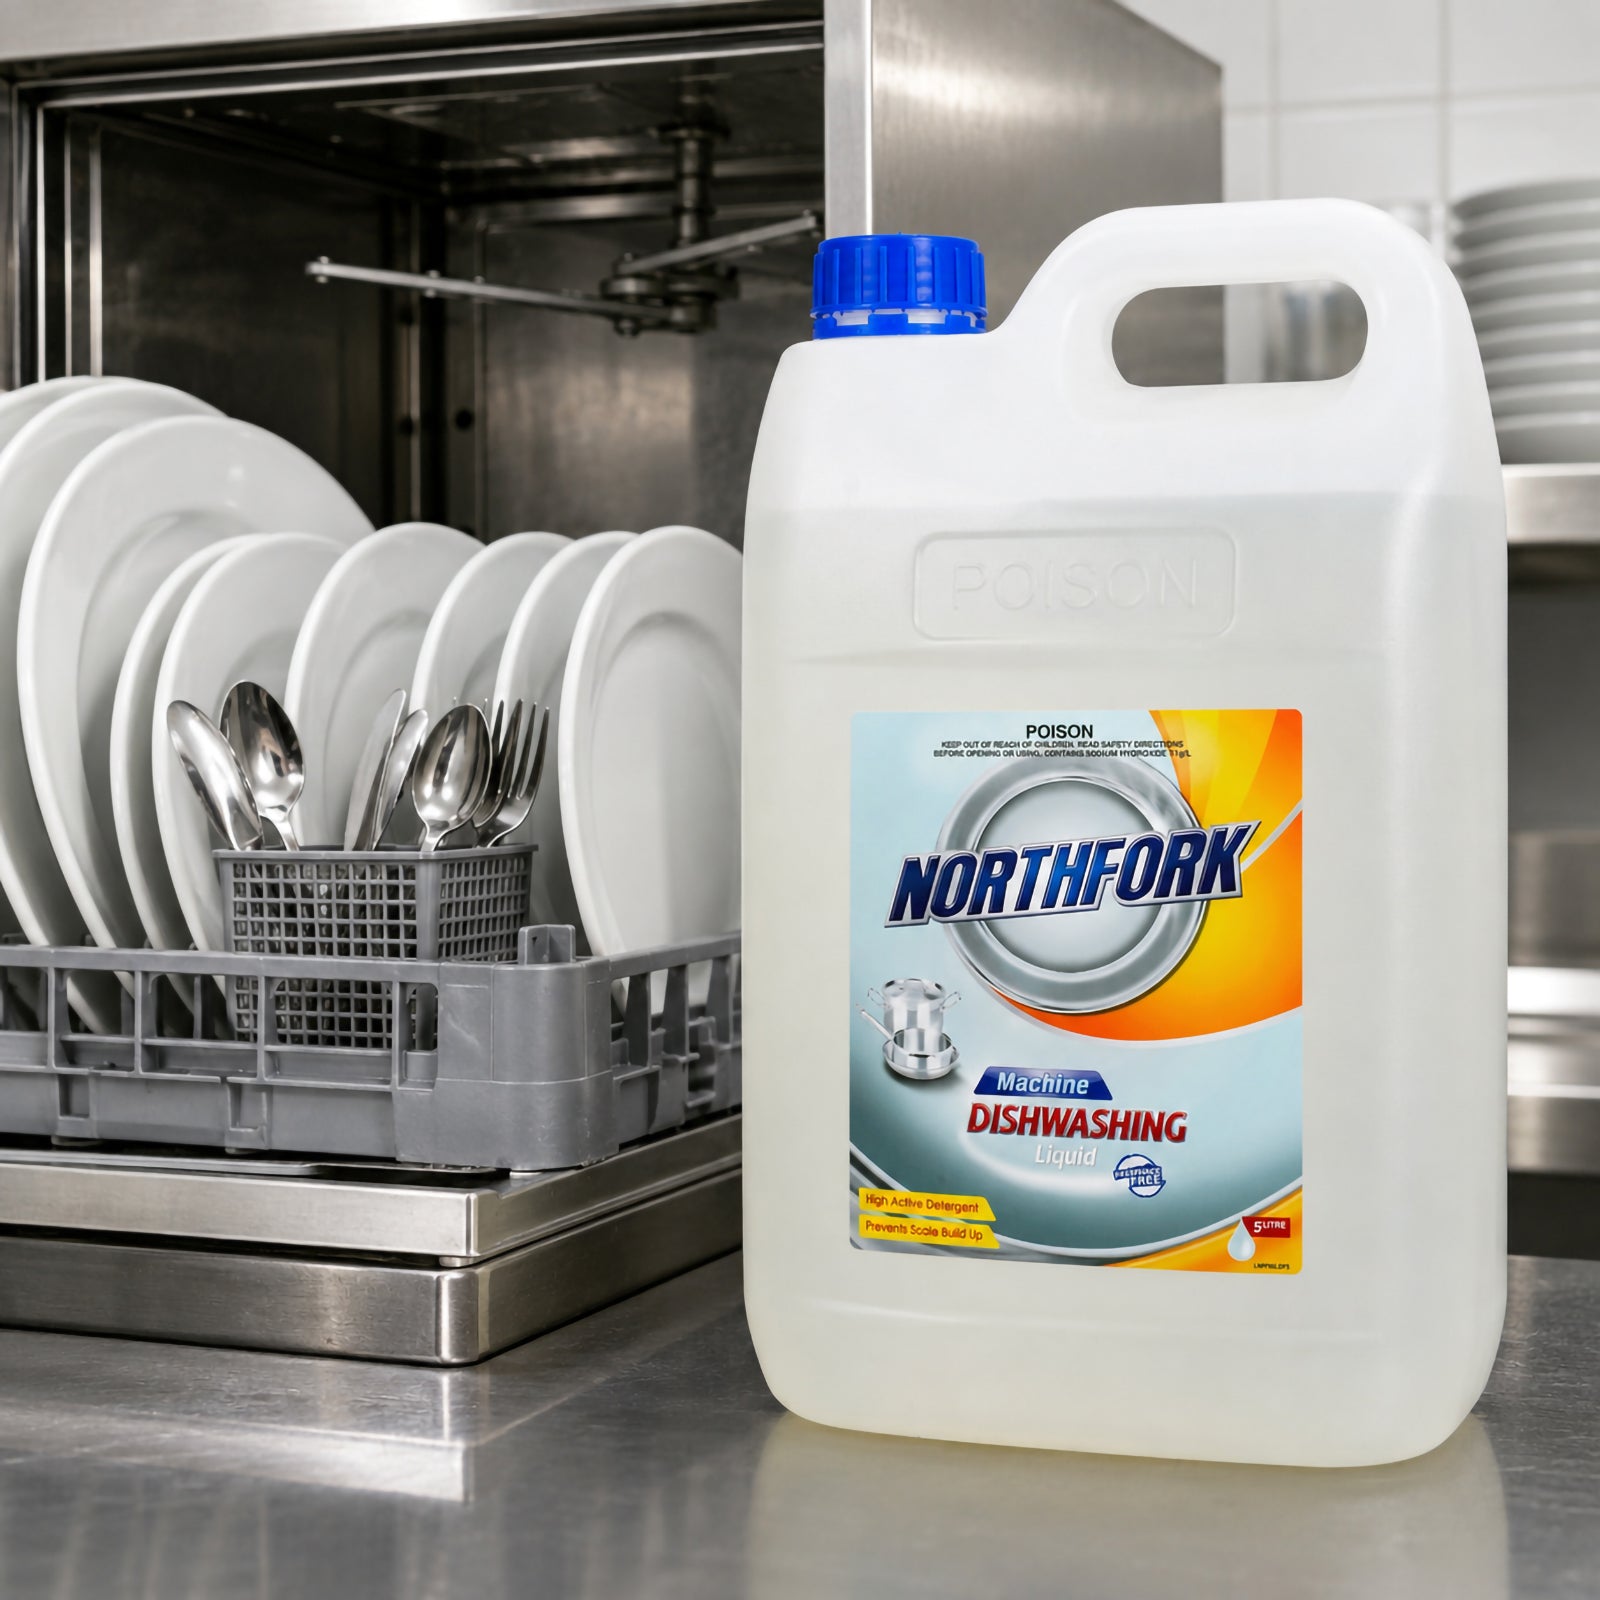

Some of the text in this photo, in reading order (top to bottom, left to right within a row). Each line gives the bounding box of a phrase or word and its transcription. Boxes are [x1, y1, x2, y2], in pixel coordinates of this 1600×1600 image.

[953, 559, 1197, 610] POISON
[1026, 724, 1093, 739] POISON
[933, 750, 965, 758] BEFORE
[966, 750, 1001, 758] OPENING
[1003, 750, 1015, 758] OR
[1044, 750, 1085, 758] CONTAINS
[1086, 750, 1118, 758] SODIUM
[1120, 750, 1167, 758] HYDROXIDE
[941, 741, 961, 749] KEEP
[963, 741, 980, 749] OUT
[981, 741, 992, 749] OF
[993, 741, 1020, 749] REACH
[1022, 741, 1032, 749] OF
[1078, 741, 1100, 749] READ
[1101, 741, 1132, 749] SAFETY
[1134, 740, 1184, 749] DIRECTIONS
[886, 822, 1258, 925] NORTHFORK
[996, 1071, 1090, 1095] Machine
[967, 1102, 1188, 1143] DISHWASHING
[1034, 1144, 1098, 1170] Liquid
[865, 1194, 979, 1214] High Active Detergent
[865, 1220, 983, 1243] Prevents Scale Build Up
